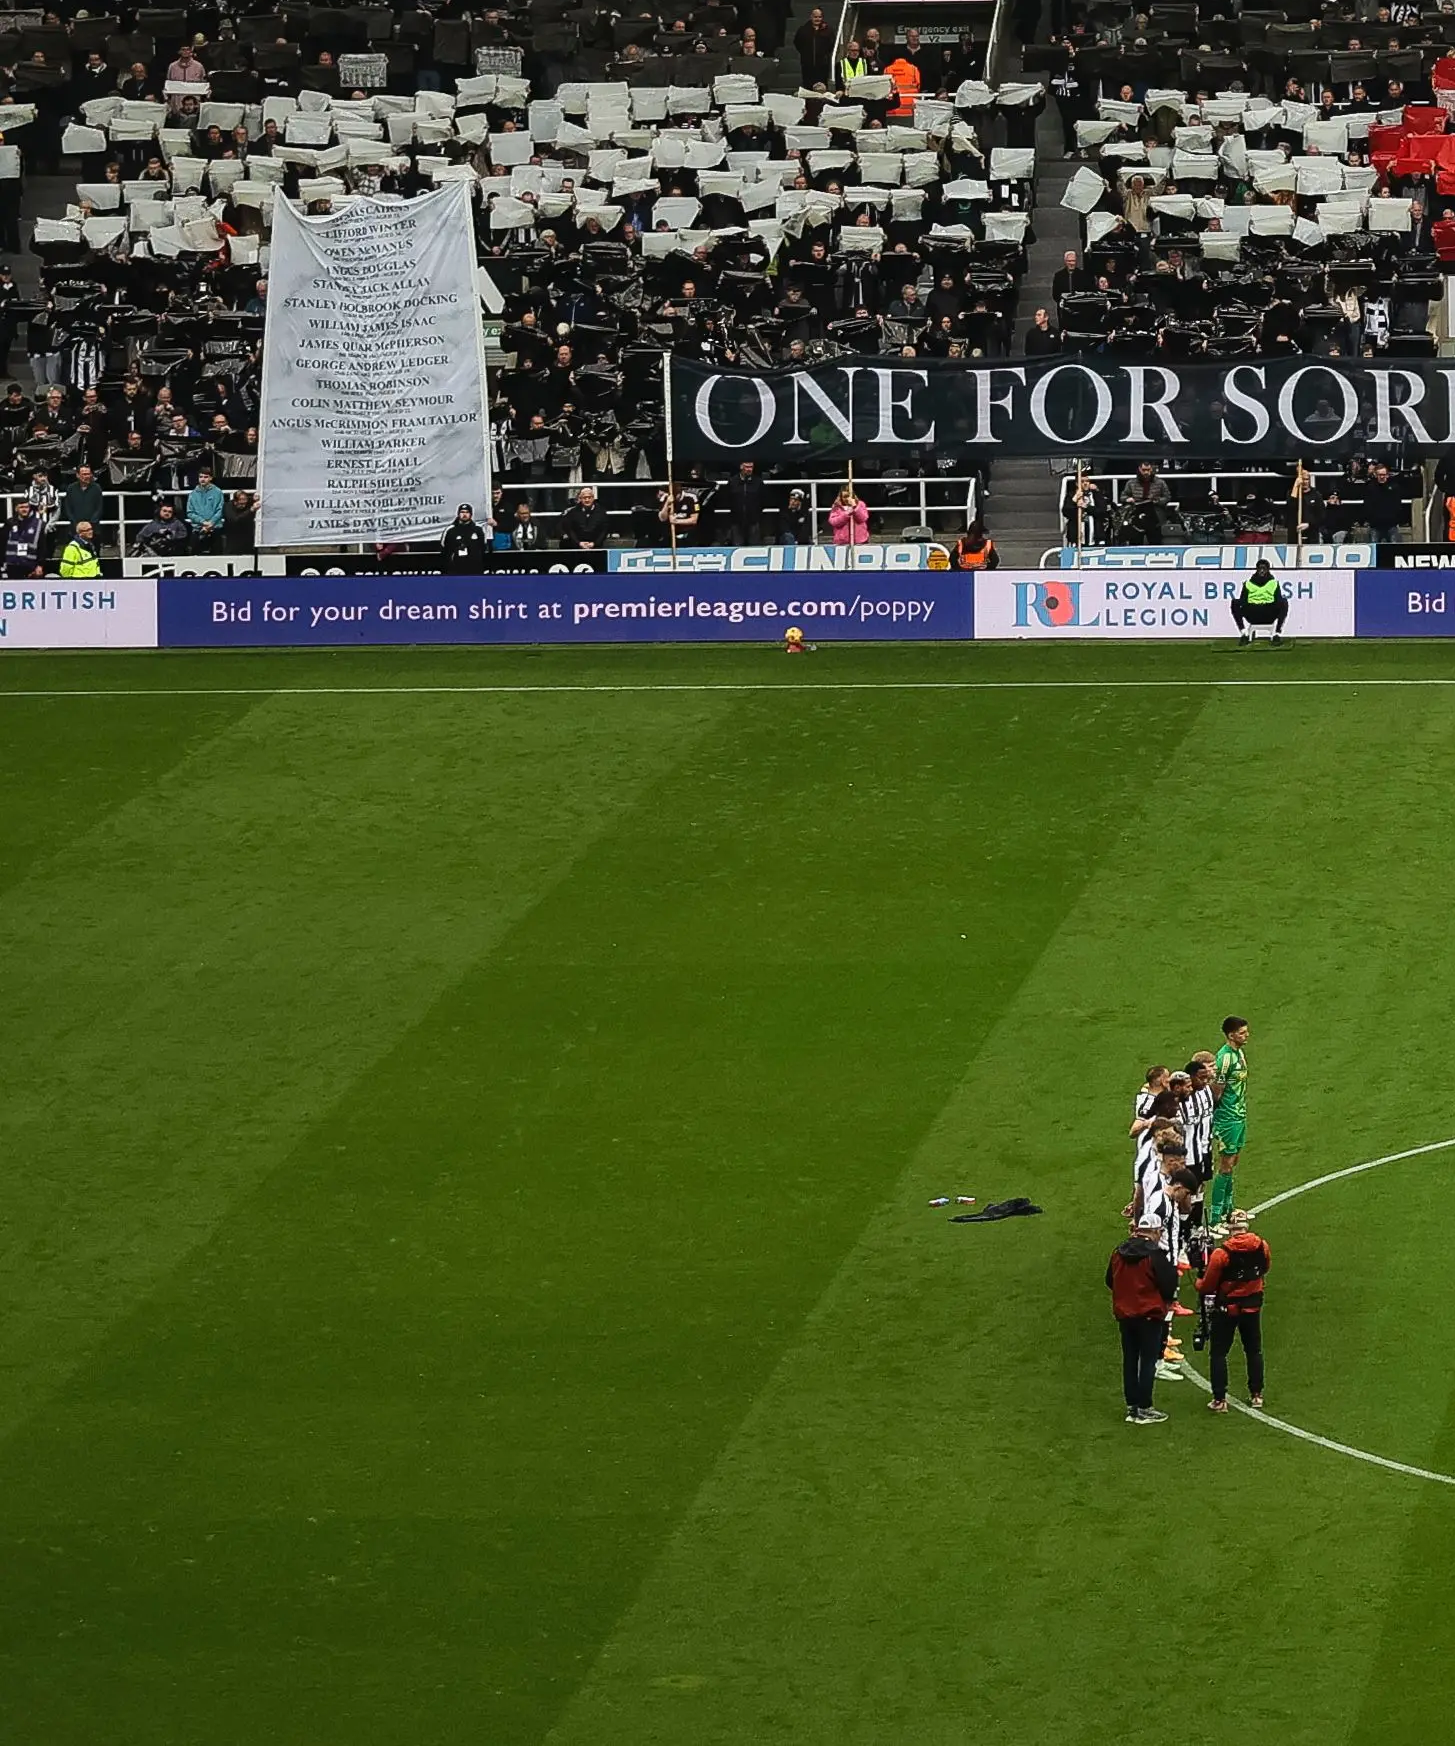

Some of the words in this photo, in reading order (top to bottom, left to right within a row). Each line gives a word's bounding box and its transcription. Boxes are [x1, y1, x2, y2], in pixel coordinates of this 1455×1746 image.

[369, 219, 417, 232] WINTER
[284, 298, 337, 309] STANLEY
[404, 293, 458, 309] DOCKING
[362, 320, 398, 333] JAMES
[401, 316, 436, 328] ISAAC
[299, 339, 339, 349] JAMES
[295, 358, 346, 370] GEORGE
[348, 360, 397, 372] ANDREW
[401, 355, 449, 368] LEDGER
[316, 380, 366, 391] THOMAS
[369, 376, 431, 391] ROBINSON
[291, 398, 330, 408] COLIN
[332, 398, 391, 410] MATTHEW
[395, 394, 455, 408] SEYMOUR
[695, 365, 935, 448] ONE
[966, 363, 1190, 444] FOR
[270, 418, 311, 429] ANGUS
[391, 416, 426, 429] FRAM
[427, 413, 478, 426] TAYLOR
[321, 438, 375, 449] WILLIAM
[378, 436, 427, 448] PARKER
[326, 458, 372, 469] ERNEST
[387, 457, 422, 468] HALL
[327, 479, 369, 489] RALPH
[370, 476, 422, 488] SHIELDS
[304, 499, 362, 510] WILLIAM
[363, 497, 406, 509] NOBLE
[408, 495, 445, 506] IMRIE
[307, 519, 350, 529] JAMES
[352, 519, 389, 529] DAVIS
[391, 515, 441, 526] TAYLOR
[1105, 582, 1193, 601] ROYAL
[2, 590, 116, 610] BRITISH
[1407, 592, 1446, 614] Bid
[212, 599, 251, 622] Bid
[263, 599, 300, 622] for
[311, 603, 369, 628] your
[379, 599, 458, 621] dream
[469, 597, 528, 620] shirt
[538, 601, 563, 620] at
[573, 595, 936, 624] premierleague.com/poppy
[1105, 608, 1209, 627] LEGION
